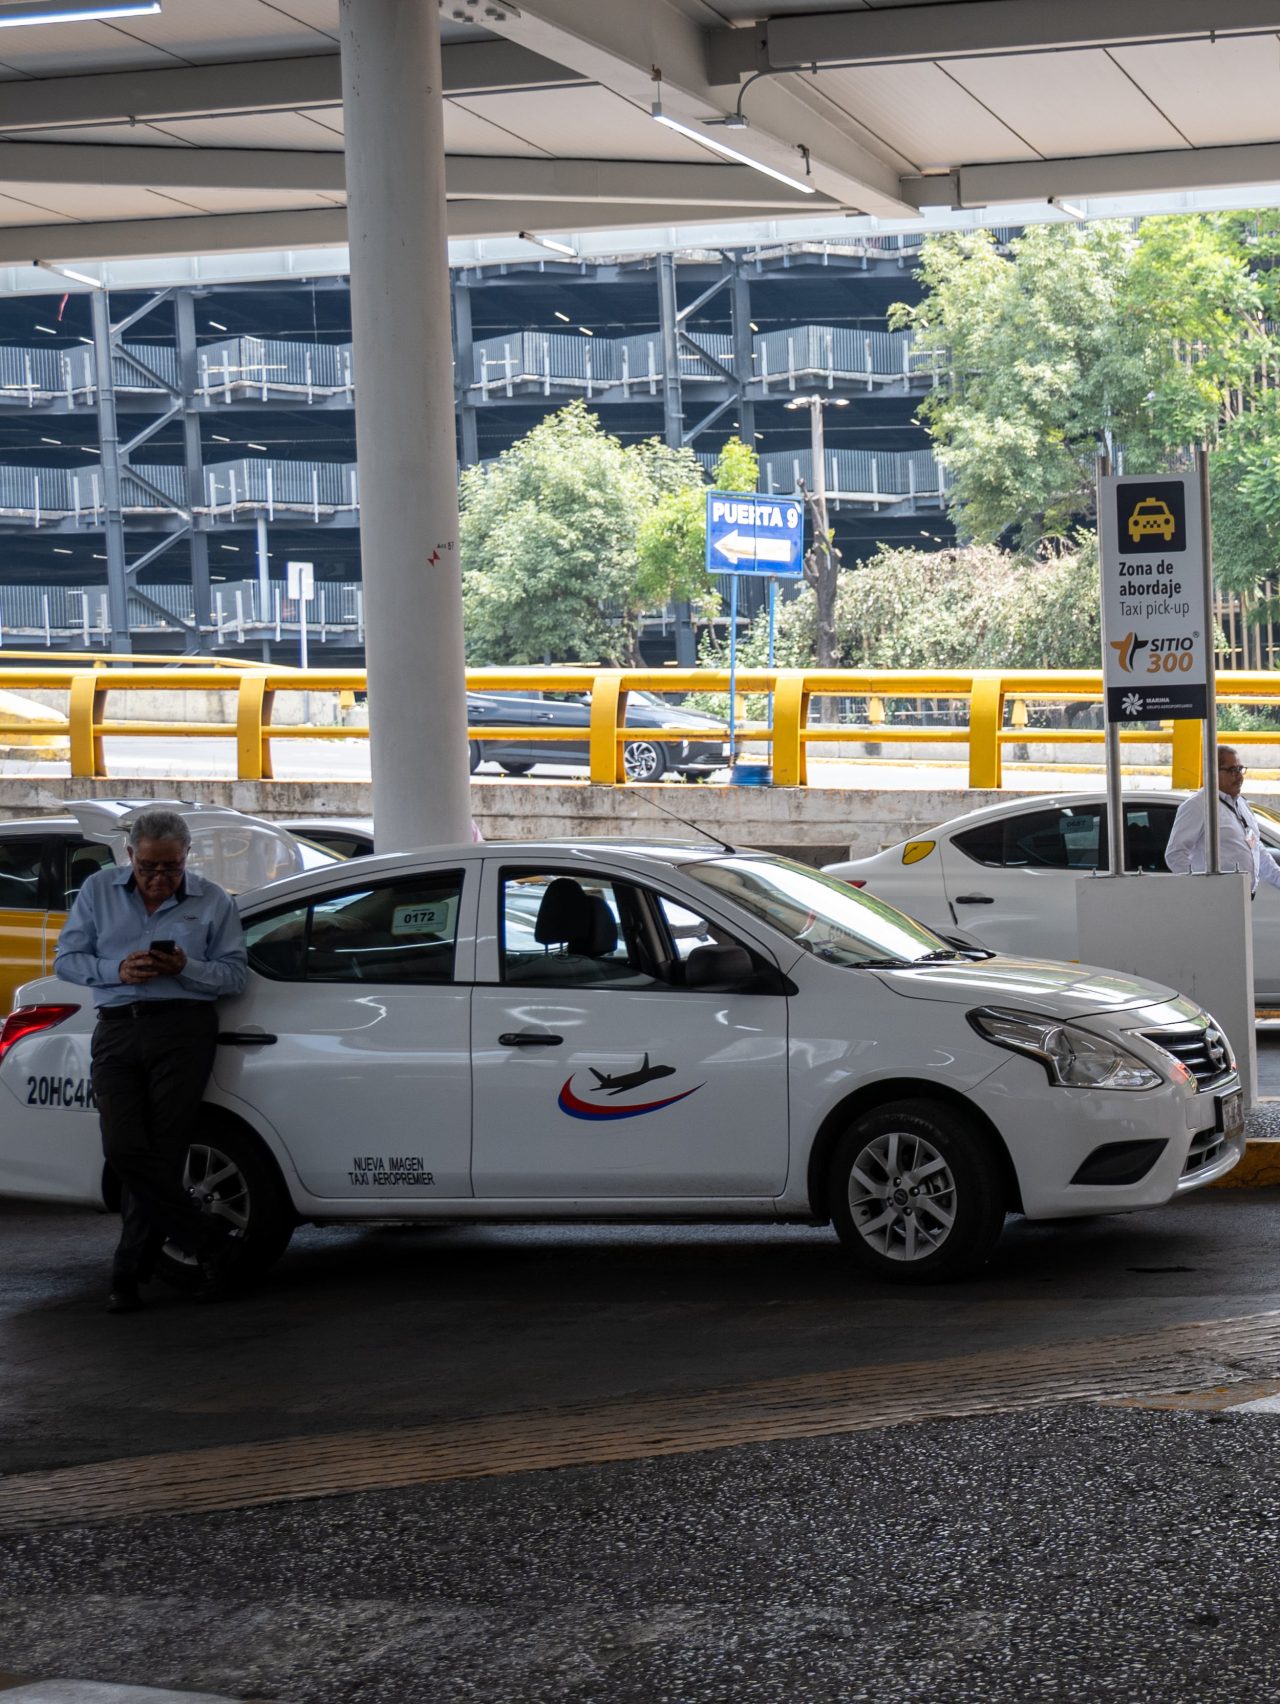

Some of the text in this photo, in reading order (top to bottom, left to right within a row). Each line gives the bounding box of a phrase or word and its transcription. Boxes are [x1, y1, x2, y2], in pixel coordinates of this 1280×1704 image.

[712, 502, 798, 529] PUERTA 9
[1118, 559, 1174, 577] Zona de
[1119, 578, 1182, 599] abordaje
[1119, 599, 1190, 620] Taxi pick-up
[1149, 637, 1194, 652] SITIO
[1146, 652, 1194, 673] 300
[403, 911, 435, 924] 0172
[353, 1157, 424, 1171] NUEVA IMAGEN
[348, 1172, 436, 1186] TAXI AEROPREMIER
